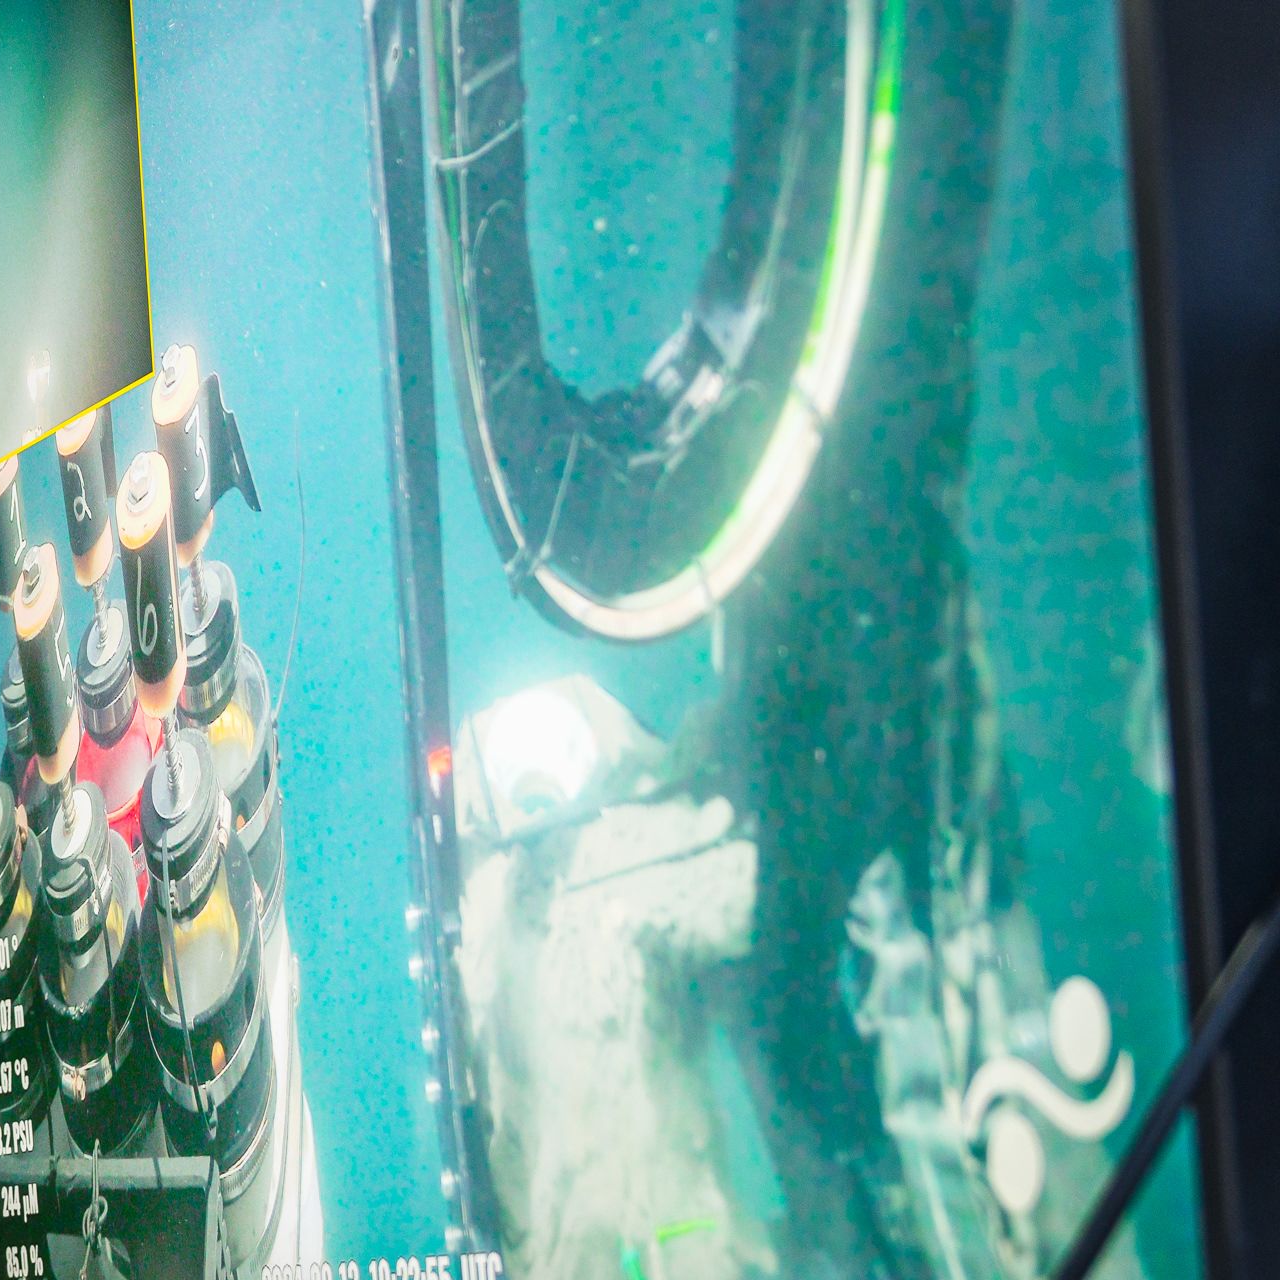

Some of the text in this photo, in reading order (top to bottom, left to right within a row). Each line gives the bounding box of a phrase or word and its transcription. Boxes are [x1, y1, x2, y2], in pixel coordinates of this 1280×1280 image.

[185, 403, 209, 501] 3
[66, 461, 93, 522] 2
[9, 480, 27, 565] 1
[136, 555, 159, 657] 6
[14, 1004, 24, 1028] m
[14, 1057, 29, 1090] °C
[12, 1119, 34, 1153] PSU
[1, 1185, 21, 1218] 244
[6, 1245, 28, 1278] 85.0
[29, 1244, 44, 1277] %
